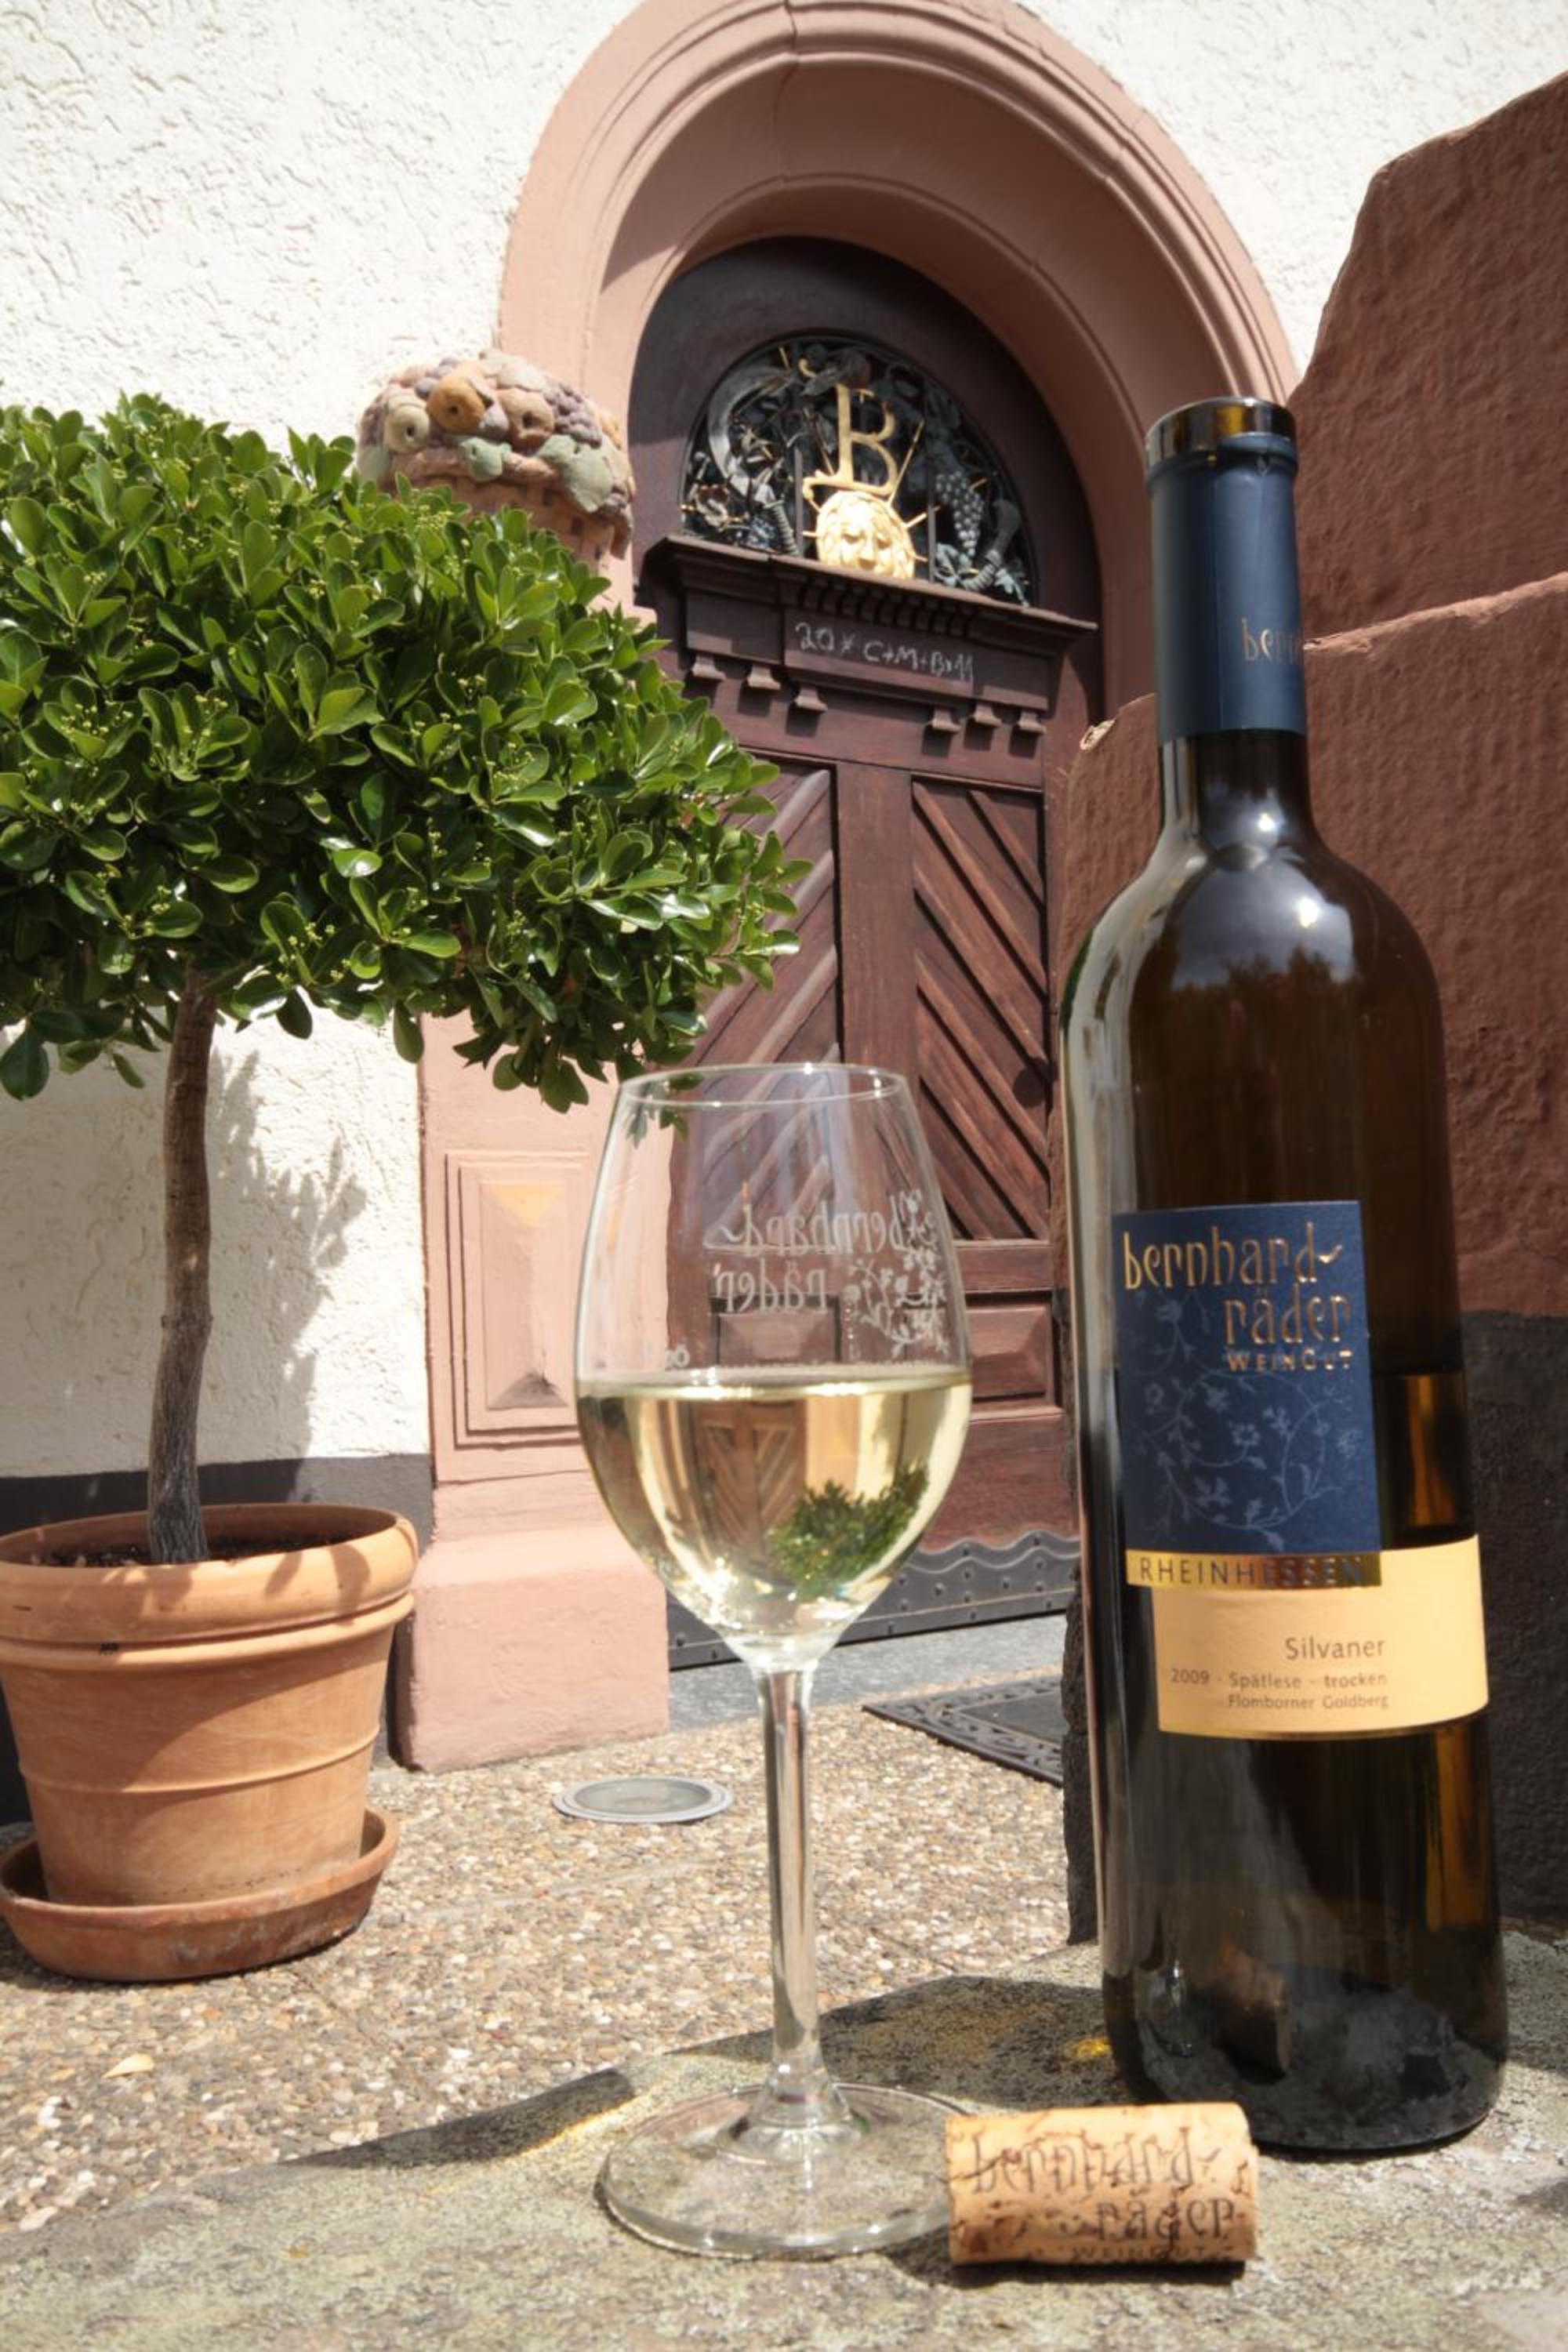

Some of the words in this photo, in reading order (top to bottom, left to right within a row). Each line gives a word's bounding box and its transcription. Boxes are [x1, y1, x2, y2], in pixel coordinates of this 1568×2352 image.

[1122, 1221, 1325, 1290] bernhard
[1223, 1281, 1352, 1346] räder
[1139, 1555, 1363, 1587] RHEINHESSEN
[1284, 1635, 1386, 1661] Silvaner
[1170, 1668, 1210, 1685] 2009
[1229, 1671, 1302, 1691] Spätlese
[1323, 1672, 1388, 1689] trocken
[1227, 1693, 1316, 1709] Flomborner
[1322, 1693, 1389, 1711] Goldberg
